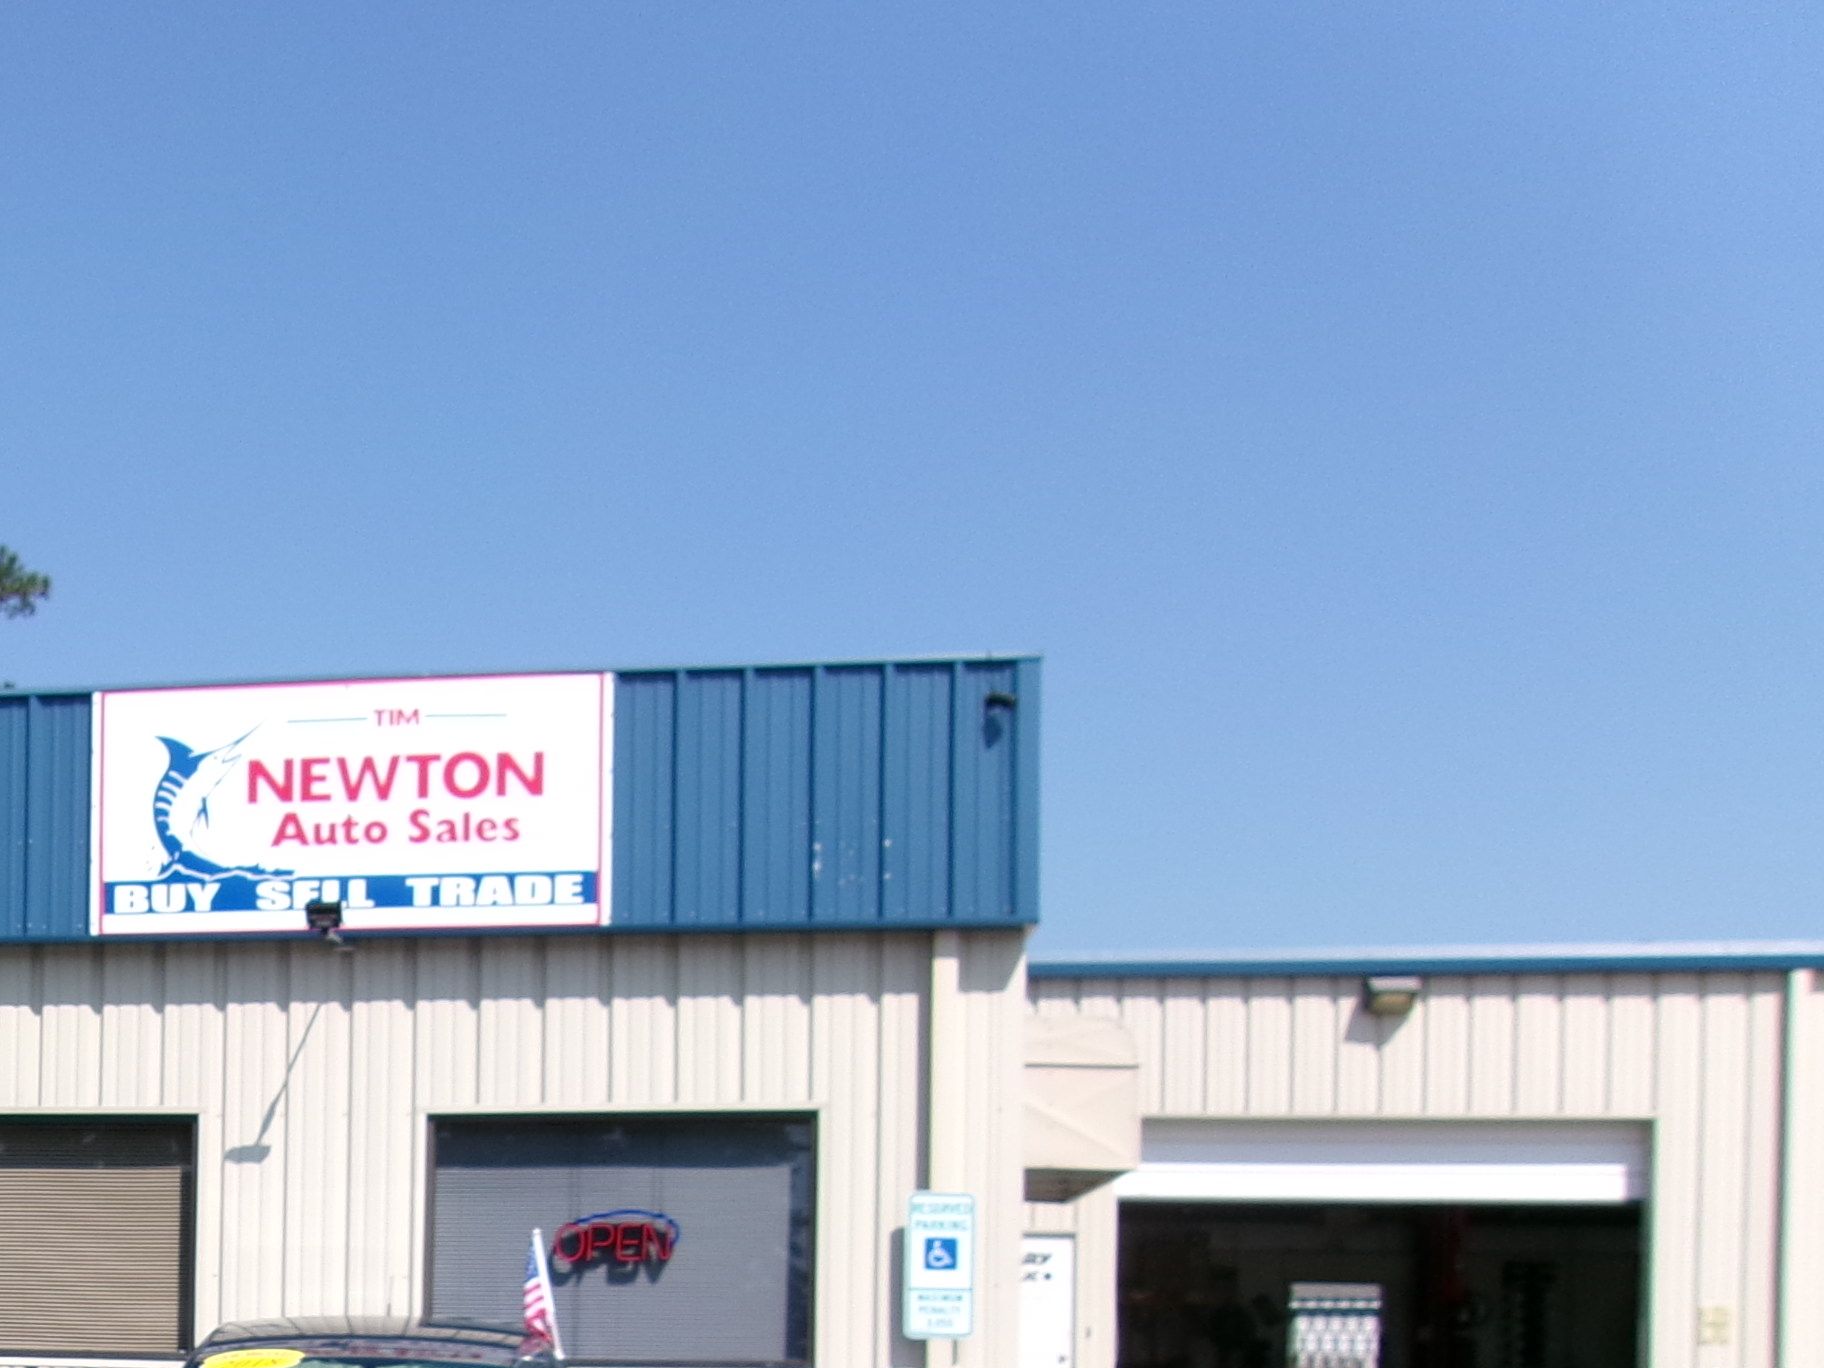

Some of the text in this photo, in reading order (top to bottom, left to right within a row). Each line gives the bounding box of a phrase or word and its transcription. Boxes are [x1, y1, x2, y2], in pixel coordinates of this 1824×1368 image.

[374, 708, 421, 727] TIM
[247, 751, 545, 804] NEWTON
[271, 808, 521, 847] Auto Sales
[113, 882, 222, 914] BUY
[405, 874, 584, 907] TRADE
[553, 1222, 675, 1263] OPEN
